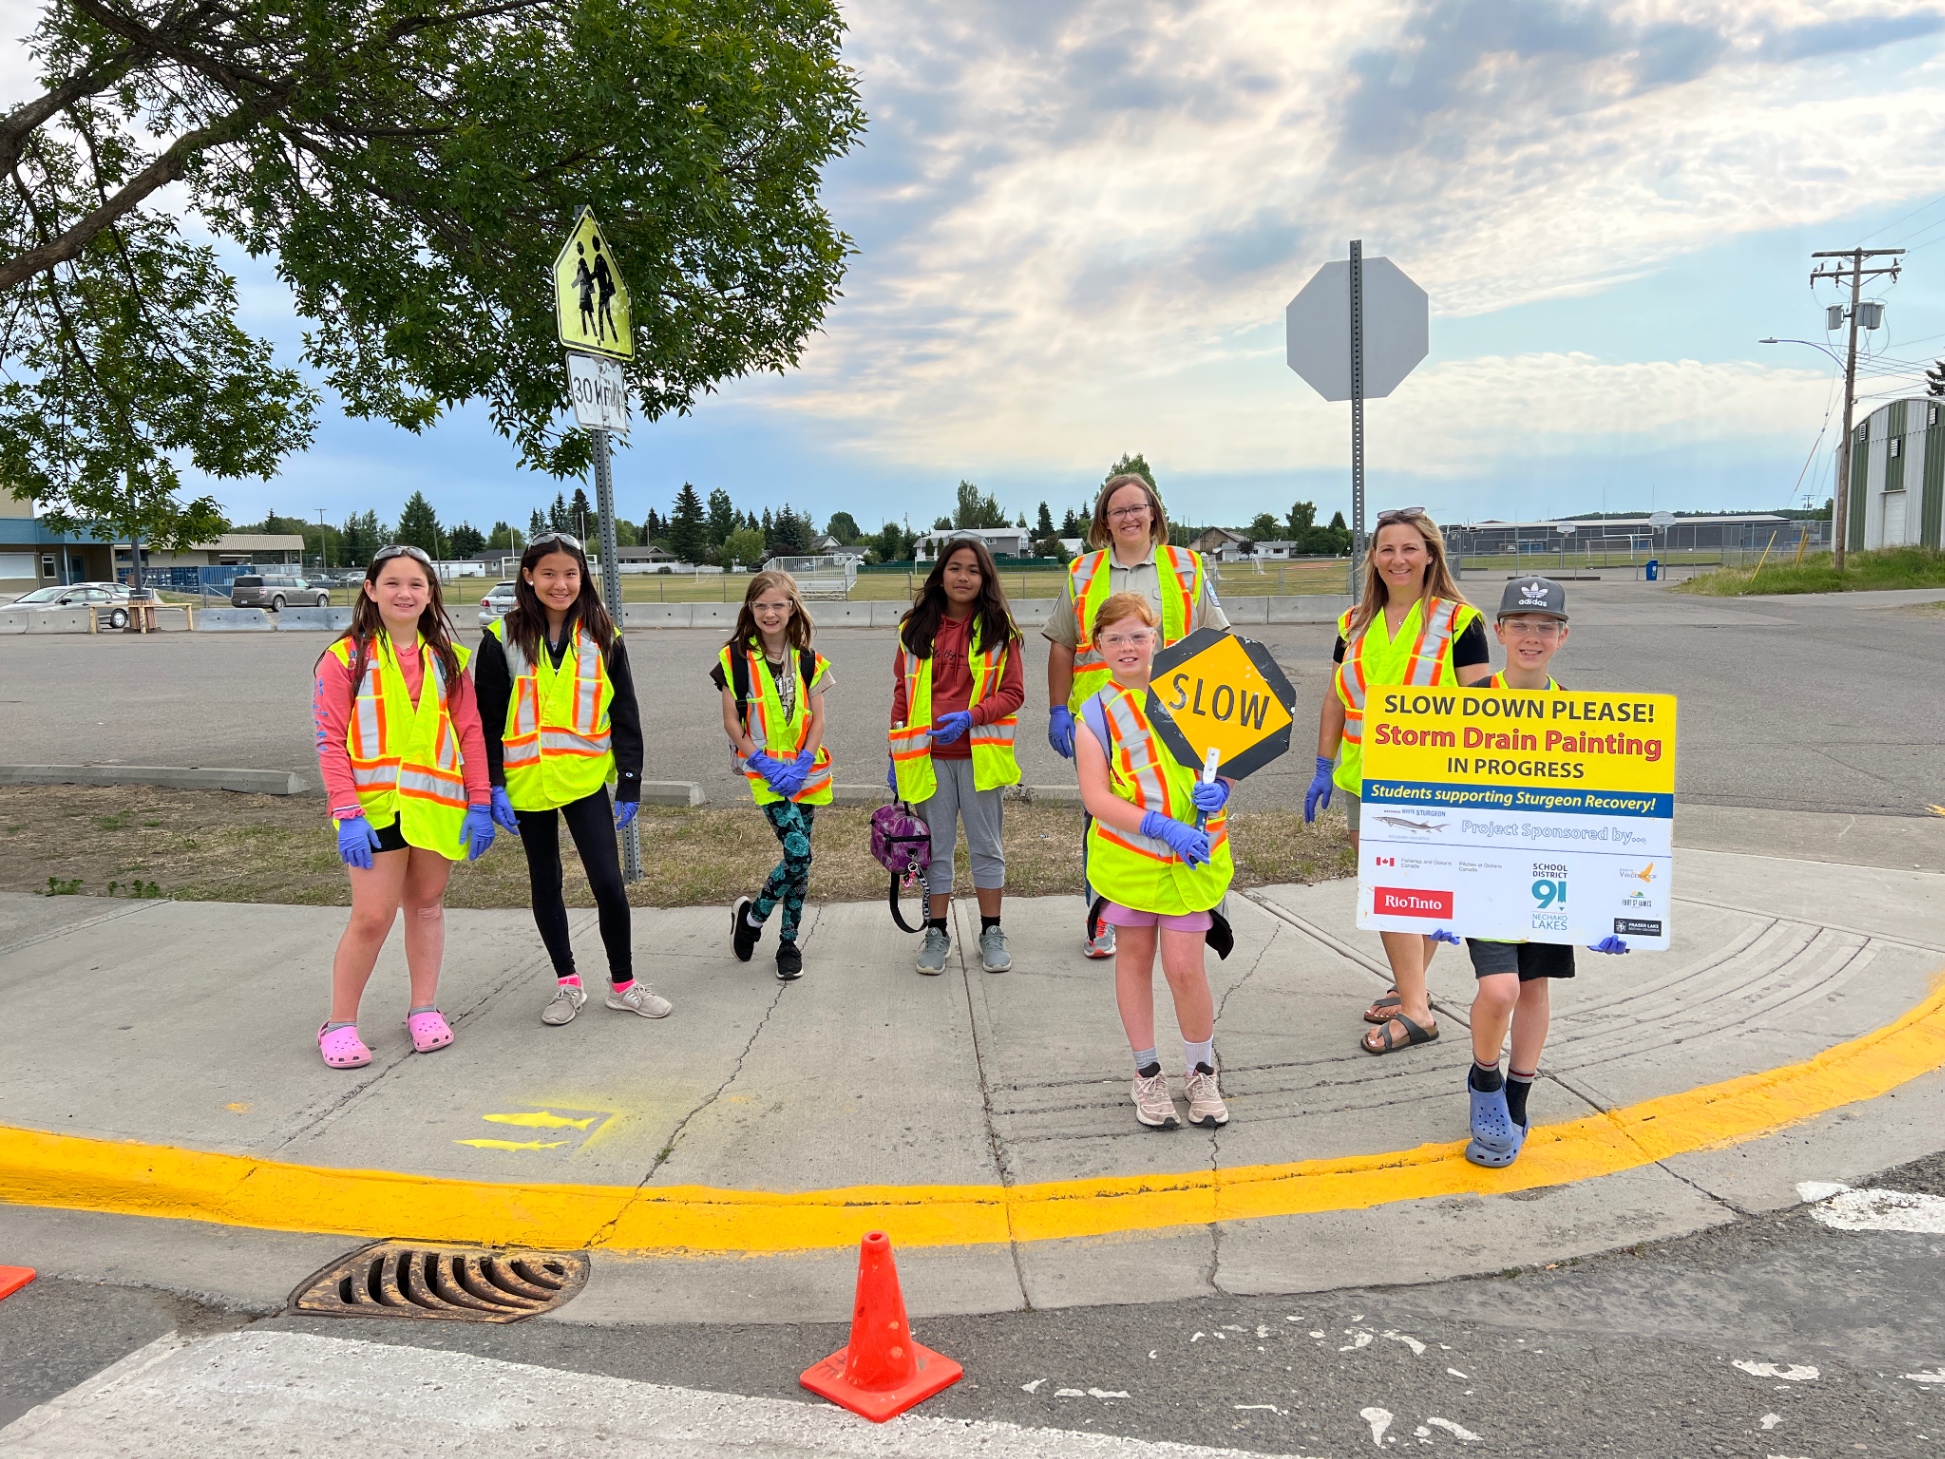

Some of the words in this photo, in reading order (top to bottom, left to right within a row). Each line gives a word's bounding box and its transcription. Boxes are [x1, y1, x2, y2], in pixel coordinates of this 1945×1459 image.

[574, 376, 593, 403] 30
[1519, 598, 1548, 607] adidas
[1168, 673, 1270, 730] SLOW
[1384, 694, 1456, 715] SLOW
[1462, 697, 1544, 719] DOWN
[1552, 700, 1655, 723] PLEASE!
[1375, 723, 1456, 748] Storm
[1463, 727, 1537, 751] Drain
[1545, 730, 1662, 762] Painting
[1447, 757, 1468, 773] IN
[1474, 758, 1585, 779] PROGRESS
[1371, 784, 1432, 799] Students
[1435, 790, 1513, 806] supporting
[1515, 791, 1582, 808] Sturgeon
[1585, 795, 1656, 813] Recovery!
[1416, 809, 1446, 817] STURGEON
[1461, 819, 1518, 837] Project
[1522, 823, 1609, 840] Sponsored
[1612, 827, 1646, 845] by...
[1533, 863, 1568, 871] SCHOOL
[1533, 870, 1568, 879] DISTRICT
[1532, 913, 1568, 922] NECHAKO
[1532, 920, 1568, 931] LAKES
